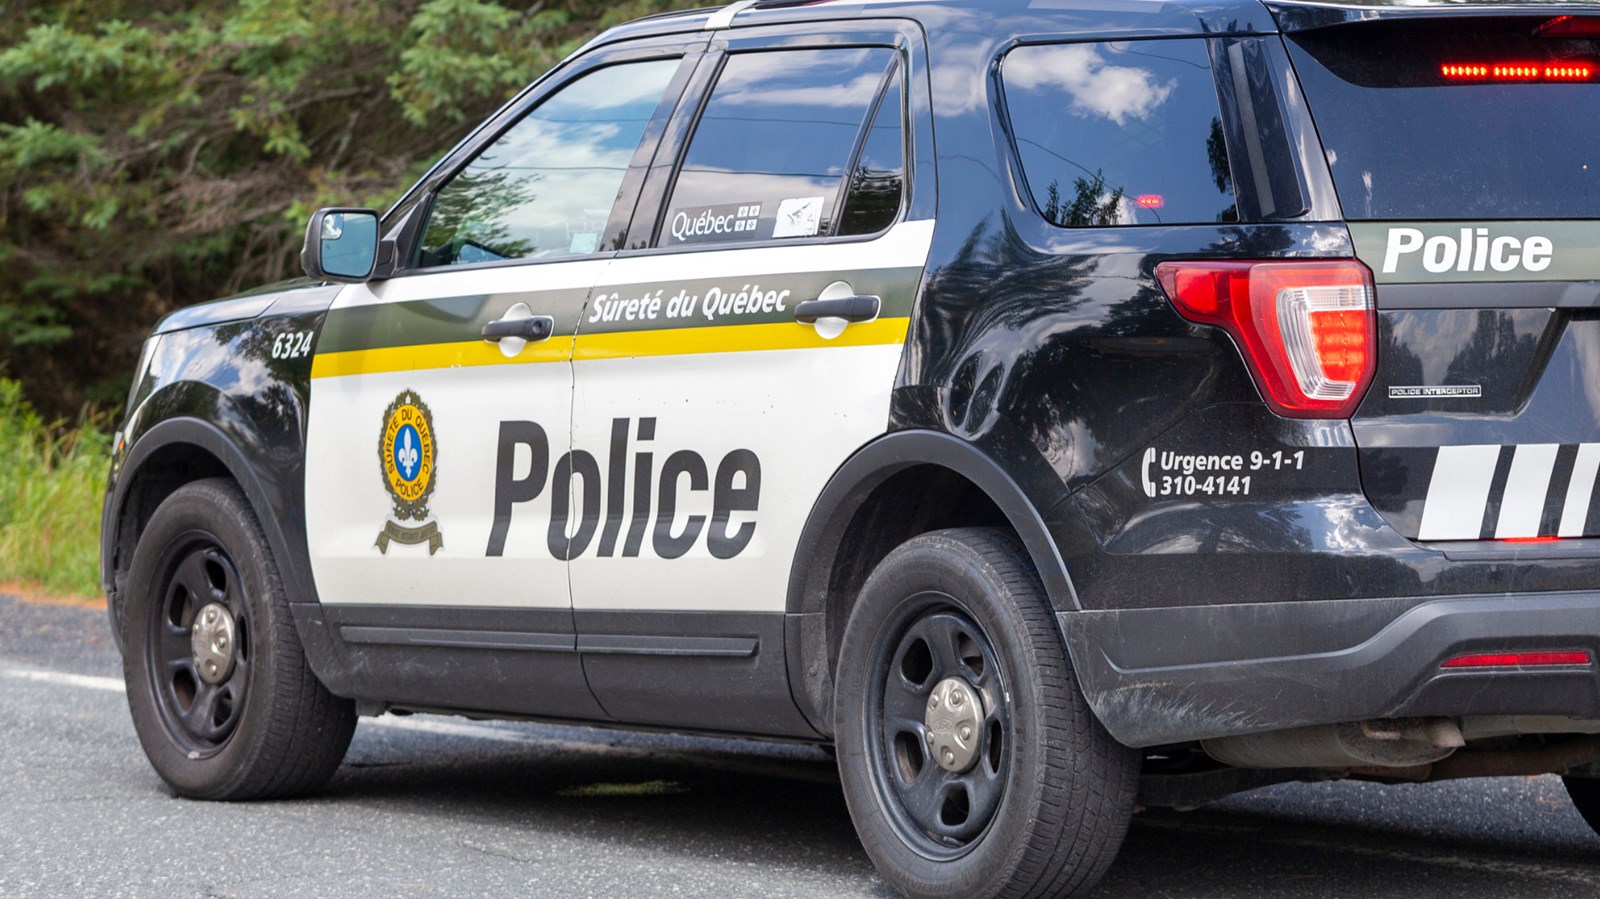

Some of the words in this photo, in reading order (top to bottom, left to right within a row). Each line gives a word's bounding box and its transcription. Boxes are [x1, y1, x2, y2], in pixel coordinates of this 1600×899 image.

[672, 209, 734, 240] Québec
[1382, 228, 1553, 273] Police
[589, 290, 663, 323] Sûreté
[666, 289, 698, 318] du
[702, 285, 790, 321] Québec
[272, 331, 314, 359] 6324
[1391, 388, 1421, 396] POLICE
[401, 408, 413, 421] DU
[1160, 451, 1243, 475] Urgence
[1249, 450, 1304, 470] 9-1-1
[395, 478, 424, 497] POLICE
[485, 416, 761, 561] Police
[1160, 476, 1251, 495] 310-4141
